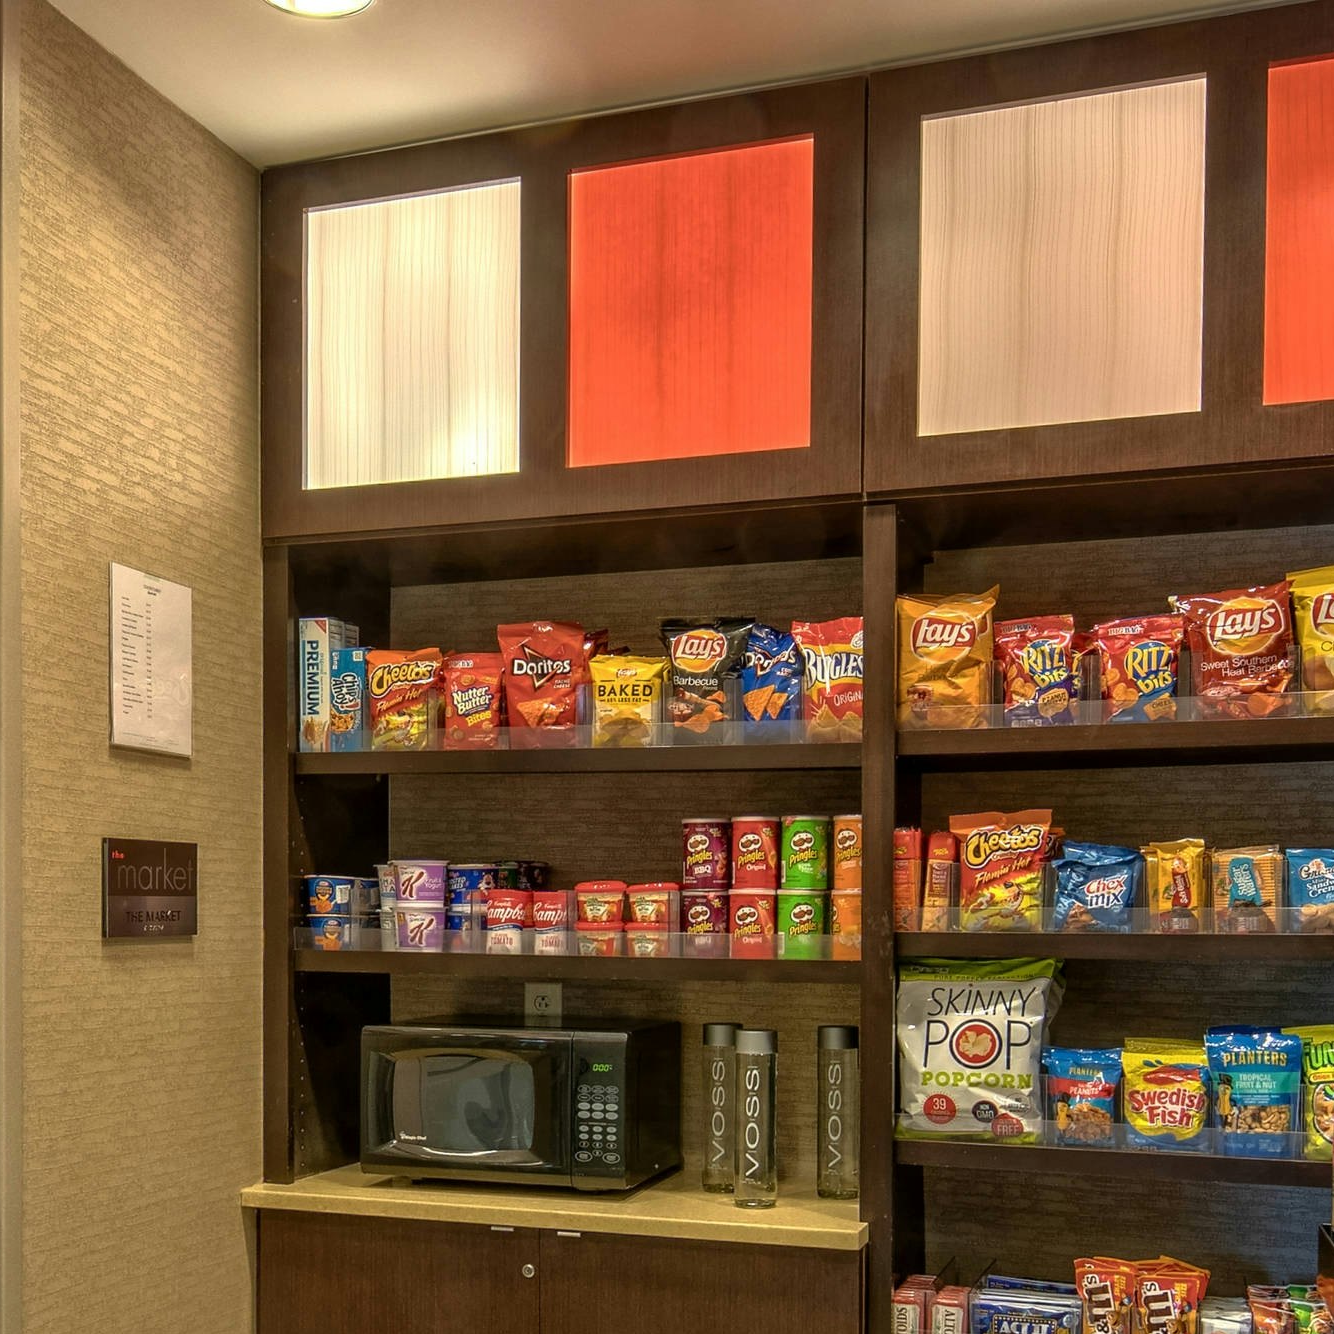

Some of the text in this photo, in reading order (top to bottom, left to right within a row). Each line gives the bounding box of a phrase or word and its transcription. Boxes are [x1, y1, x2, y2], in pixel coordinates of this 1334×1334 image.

[1214, 606, 1276, 640] Lay's
[915, 618, 974, 649] Lay's
[674, 633, 724, 661] Lay's
[512, 659, 572, 676] Doritos
[1021, 643, 1067, 676] RITZ
[1126, 644, 1173, 681] RITZ
[1200, 654, 1278, 673] Sweet Southern
[306, 640, 320, 717] PREMIUM
[371, 662, 435, 697] Cheetos
[673, 675, 719, 687] Barbecue
[1034, 667, 1068, 689] bits
[1136, 670, 1173, 694] bits
[1221, 666, 1246, 678] Heat
[452, 685, 489, 705] Nutter
[597, 683, 654, 698] BAKED
[457, 693, 493, 715] Butter
[466, 711, 492, 728] Bites
[966, 824, 1043, 868] Cheetos
[686, 850, 713, 869] Pringles
[737, 849, 765, 868] Pringles
[789, 848, 818, 868] Pringles
[117, 847, 194, 891] market
[1084, 875, 1128, 895] Chex
[1086, 888, 1124, 910] mix
[125, 910, 182, 923] THE MARKET
[734, 921, 762, 938] Pringles
[789, 920, 817, 937] Pringles
[923, 1019, 1033, 1070] POP
[1222, 1050, 1288, 1068] PLANTERS
[920, 1071, 1034, 1090] POPCORN
[1238, 1073, 1272, 1082] TROPICAL
[932, 1097, 948, 1111] 39
[1127, 1087, 1205, 1114] Swedish
[1145, 1104, 1195, 1129] Fish
[999, 1321, 1028, 1334] ACT
